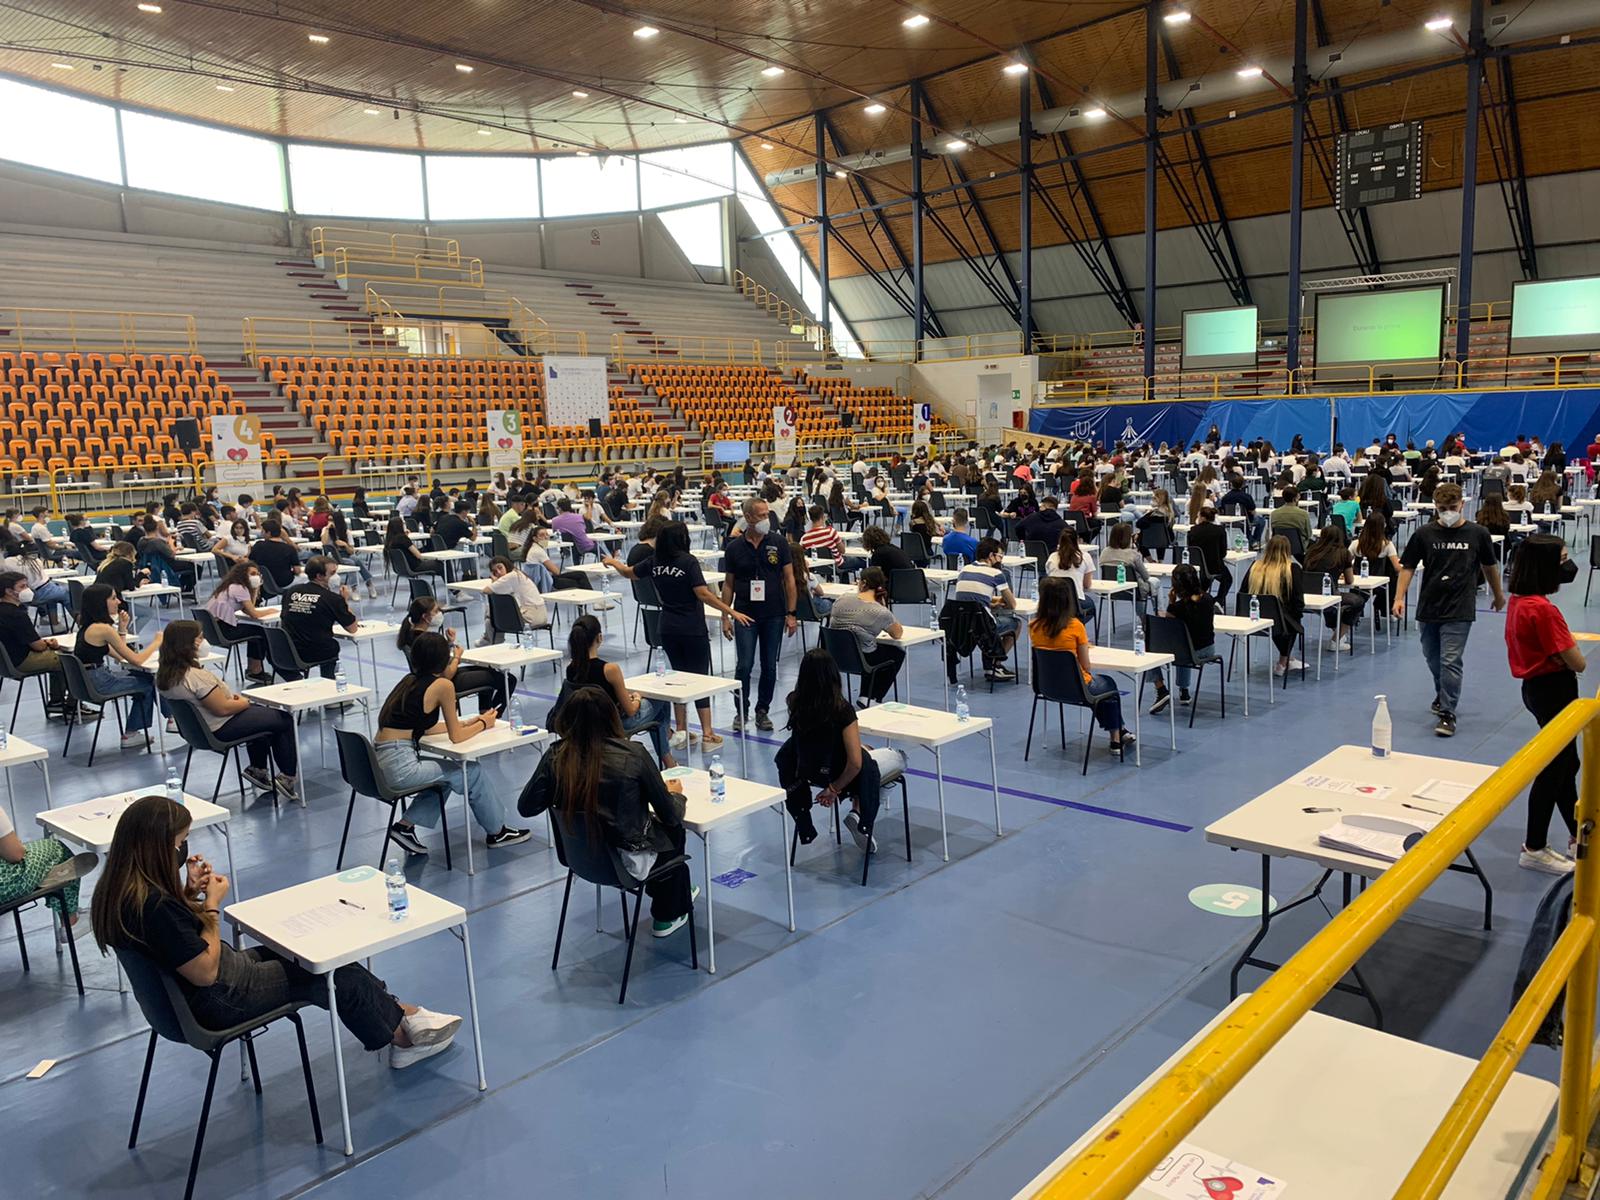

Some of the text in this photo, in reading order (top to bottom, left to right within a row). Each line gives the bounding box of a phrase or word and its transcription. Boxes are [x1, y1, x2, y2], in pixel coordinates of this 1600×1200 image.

[506, 414, 517, 432] 3
[786, 409, 793, 424] 2
[240, 419, 254, 440] 4
[652, 565, 686, 578] STAFF
[298, 593, 321, 603] VANS
[1212, 891, 1250, 910] 5
